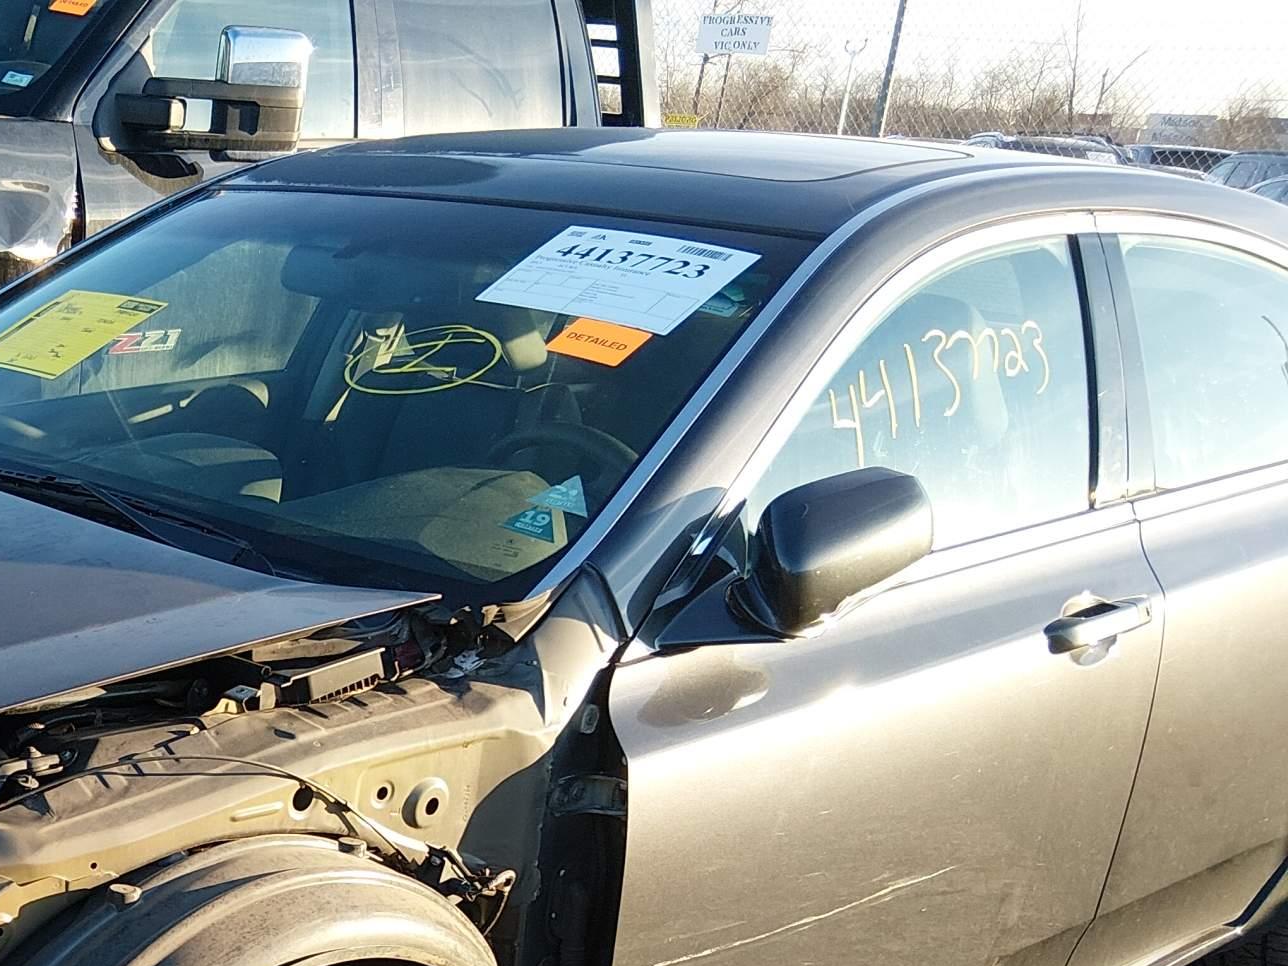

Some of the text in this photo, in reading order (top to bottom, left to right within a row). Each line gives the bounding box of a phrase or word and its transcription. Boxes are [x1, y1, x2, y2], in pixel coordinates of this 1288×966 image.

[703, 15, 772, 26] PROGRESSIVE
[720, 27, 747, 37] CARS
[733, 41, 760, 50] ONLY
[556, 244, 711, 279] 44137723
[566, 331, 628, 350] DETAILED
